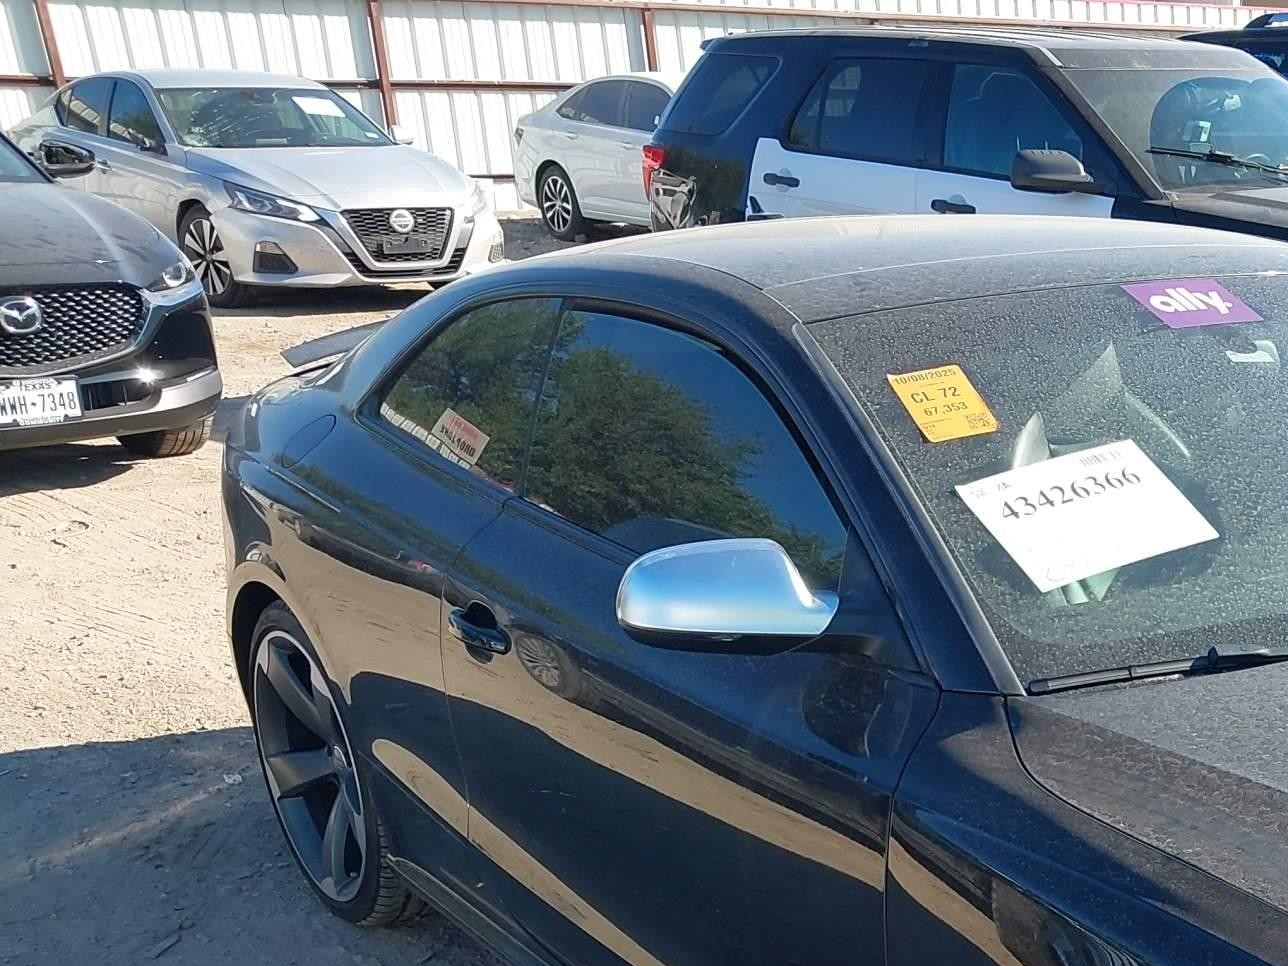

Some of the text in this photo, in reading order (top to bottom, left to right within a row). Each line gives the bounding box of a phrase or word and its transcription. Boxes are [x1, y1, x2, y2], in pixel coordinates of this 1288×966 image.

[894, 368, 957, 385] 10/08/2025
[910, 386, 962, 404] CL 72
[1002, 467, 1142, 519] 43426366
